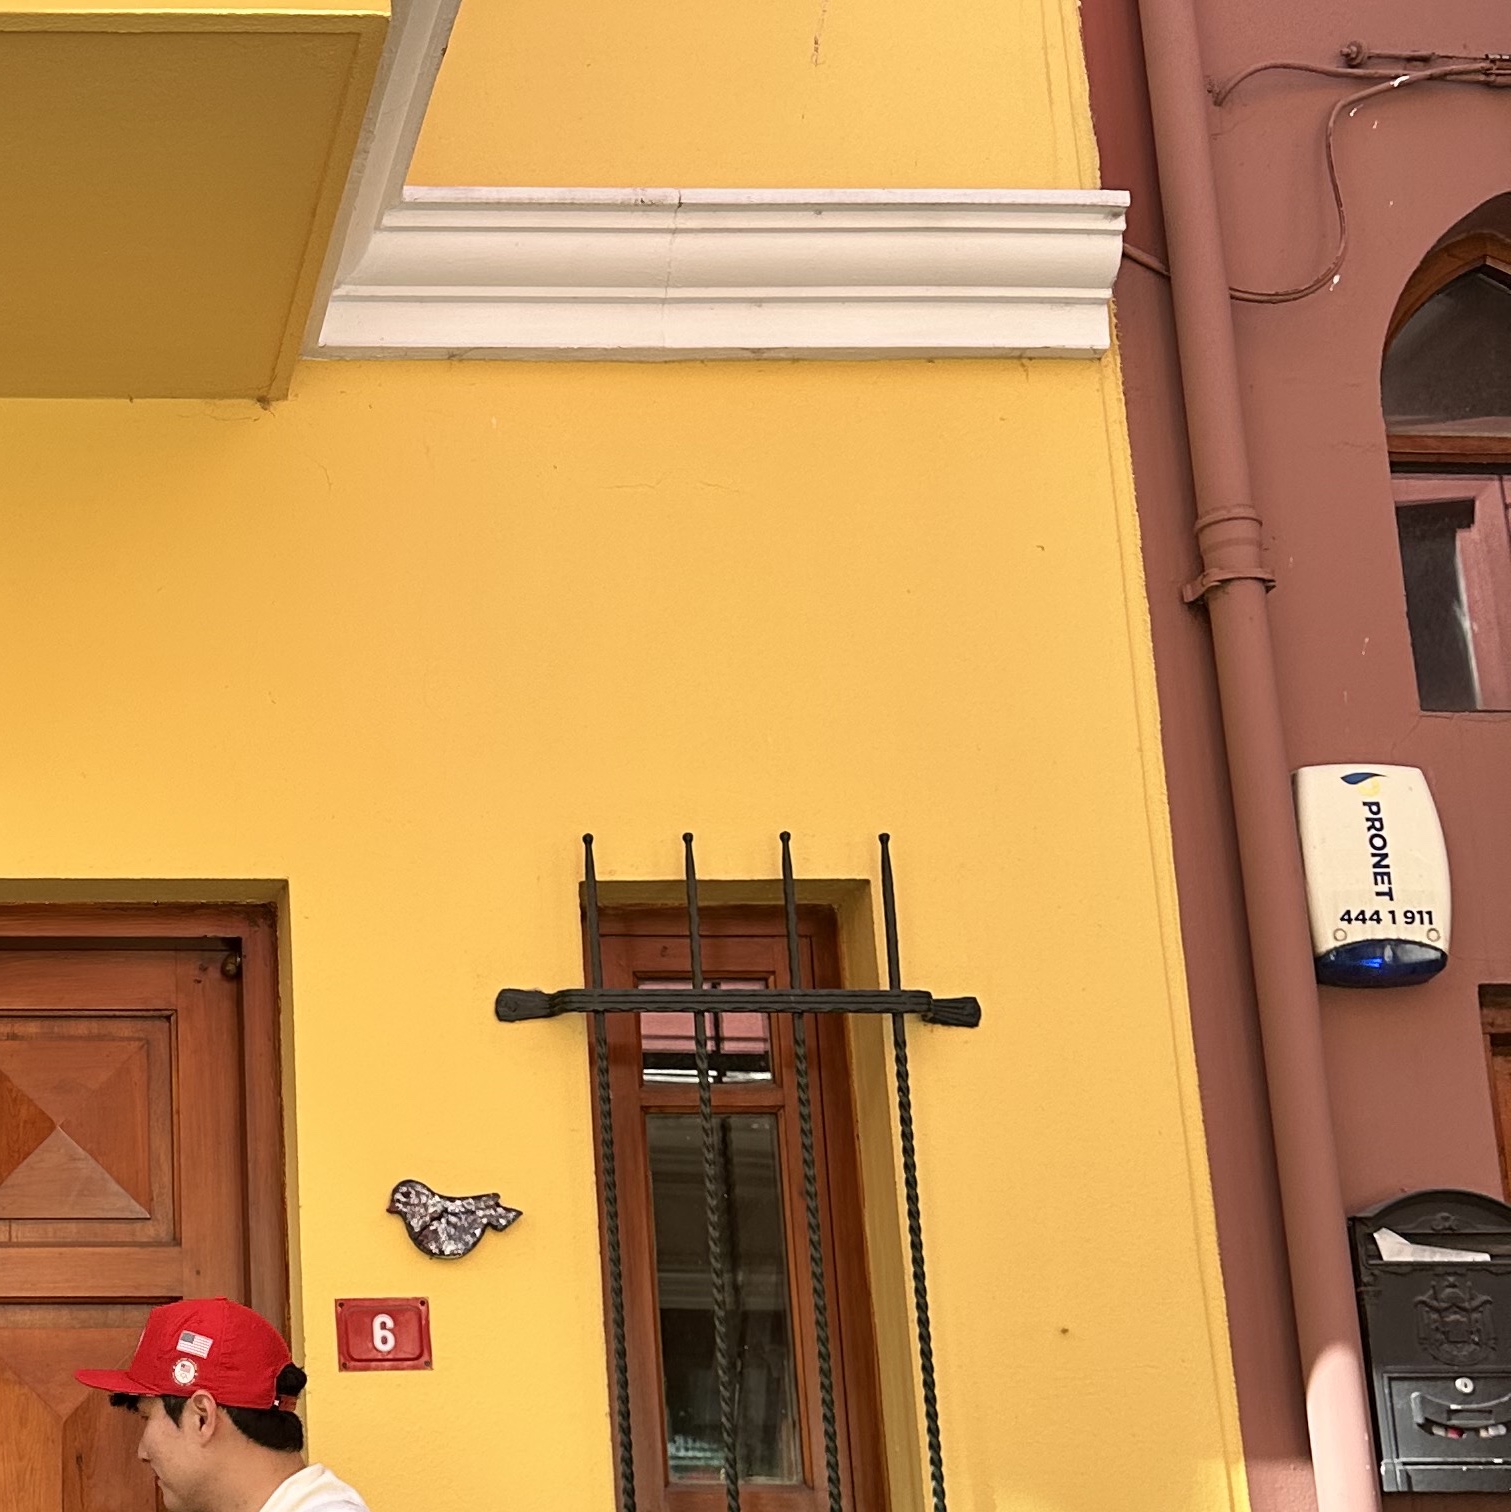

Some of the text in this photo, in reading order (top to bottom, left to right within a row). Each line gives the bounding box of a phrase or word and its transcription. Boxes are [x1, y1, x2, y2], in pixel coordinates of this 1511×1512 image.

[1362, 801, 1394, 901] PRONET
[1340, 910, 1434, 926] 444 1 911
[372, 1313, 396, 1353] 6
